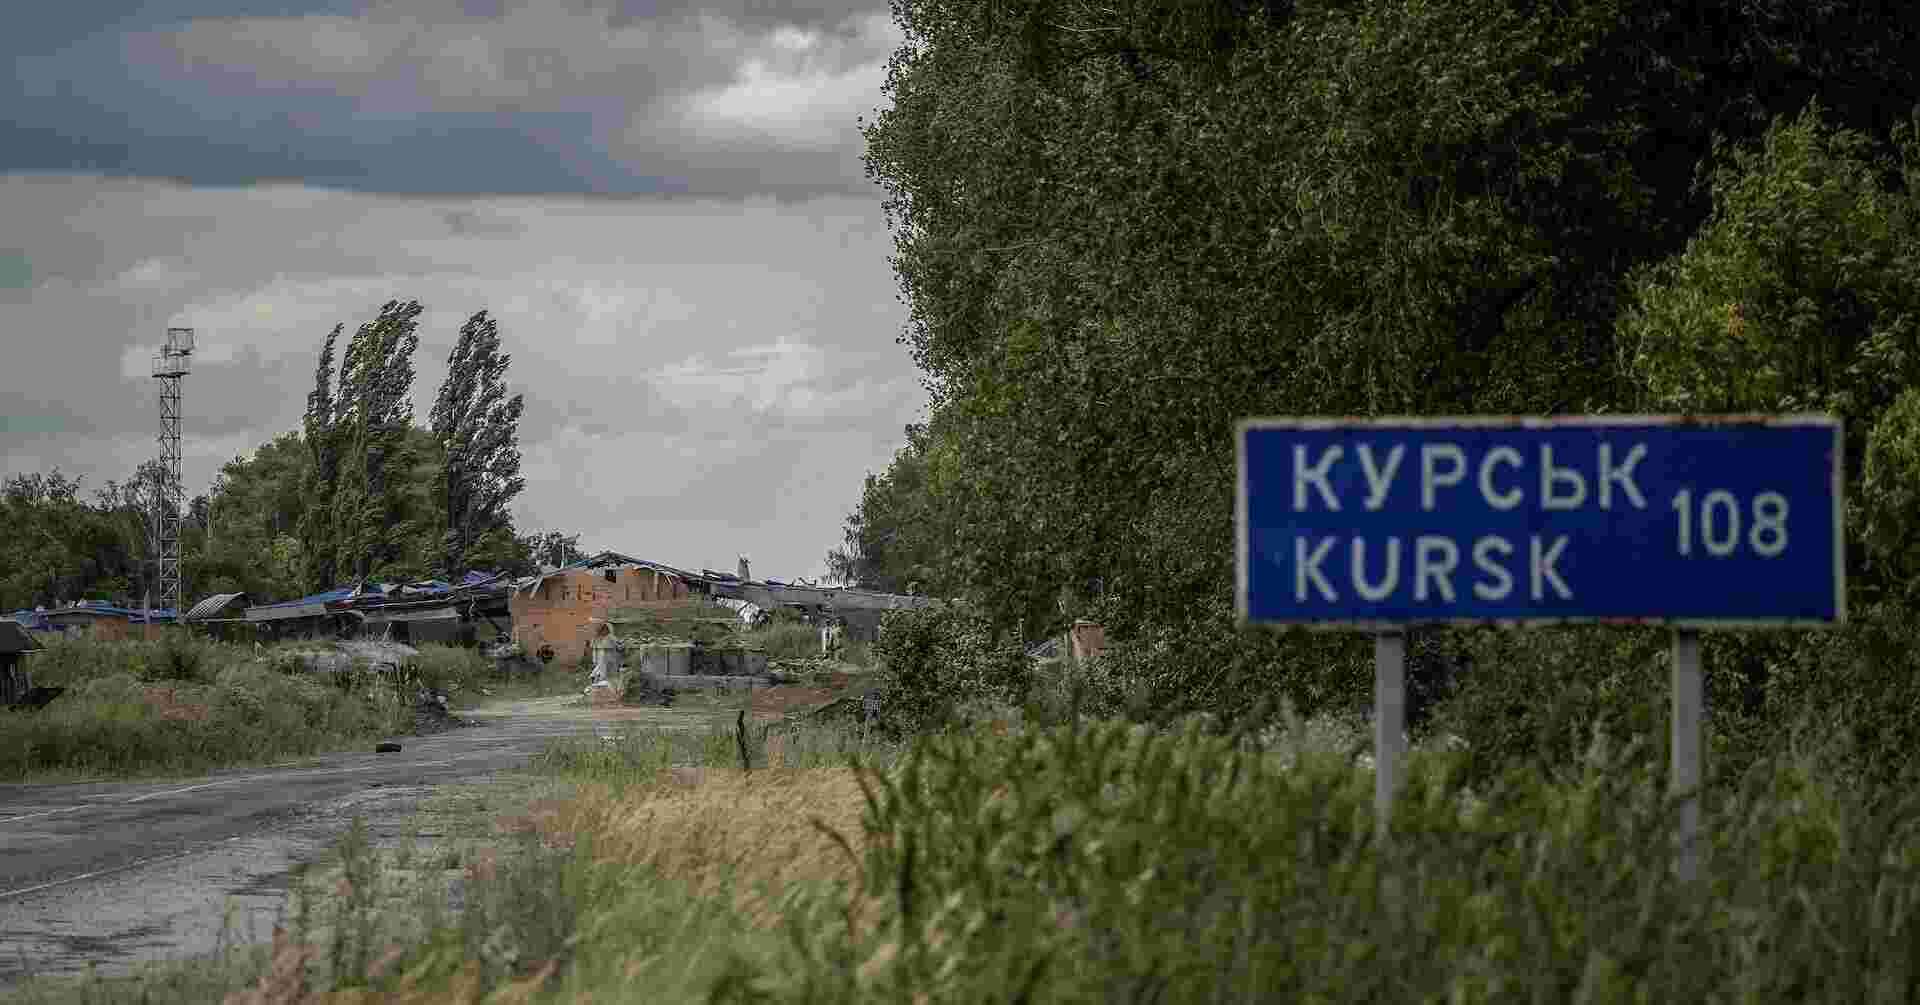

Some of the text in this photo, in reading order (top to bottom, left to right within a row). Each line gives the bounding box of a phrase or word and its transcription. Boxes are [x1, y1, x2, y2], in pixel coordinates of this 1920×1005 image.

[1292, 443, 1647, 511] КУРСЬК
[1671, 488, 1790, 557] 108
[1294, 534, 1573, 602] KURSK
